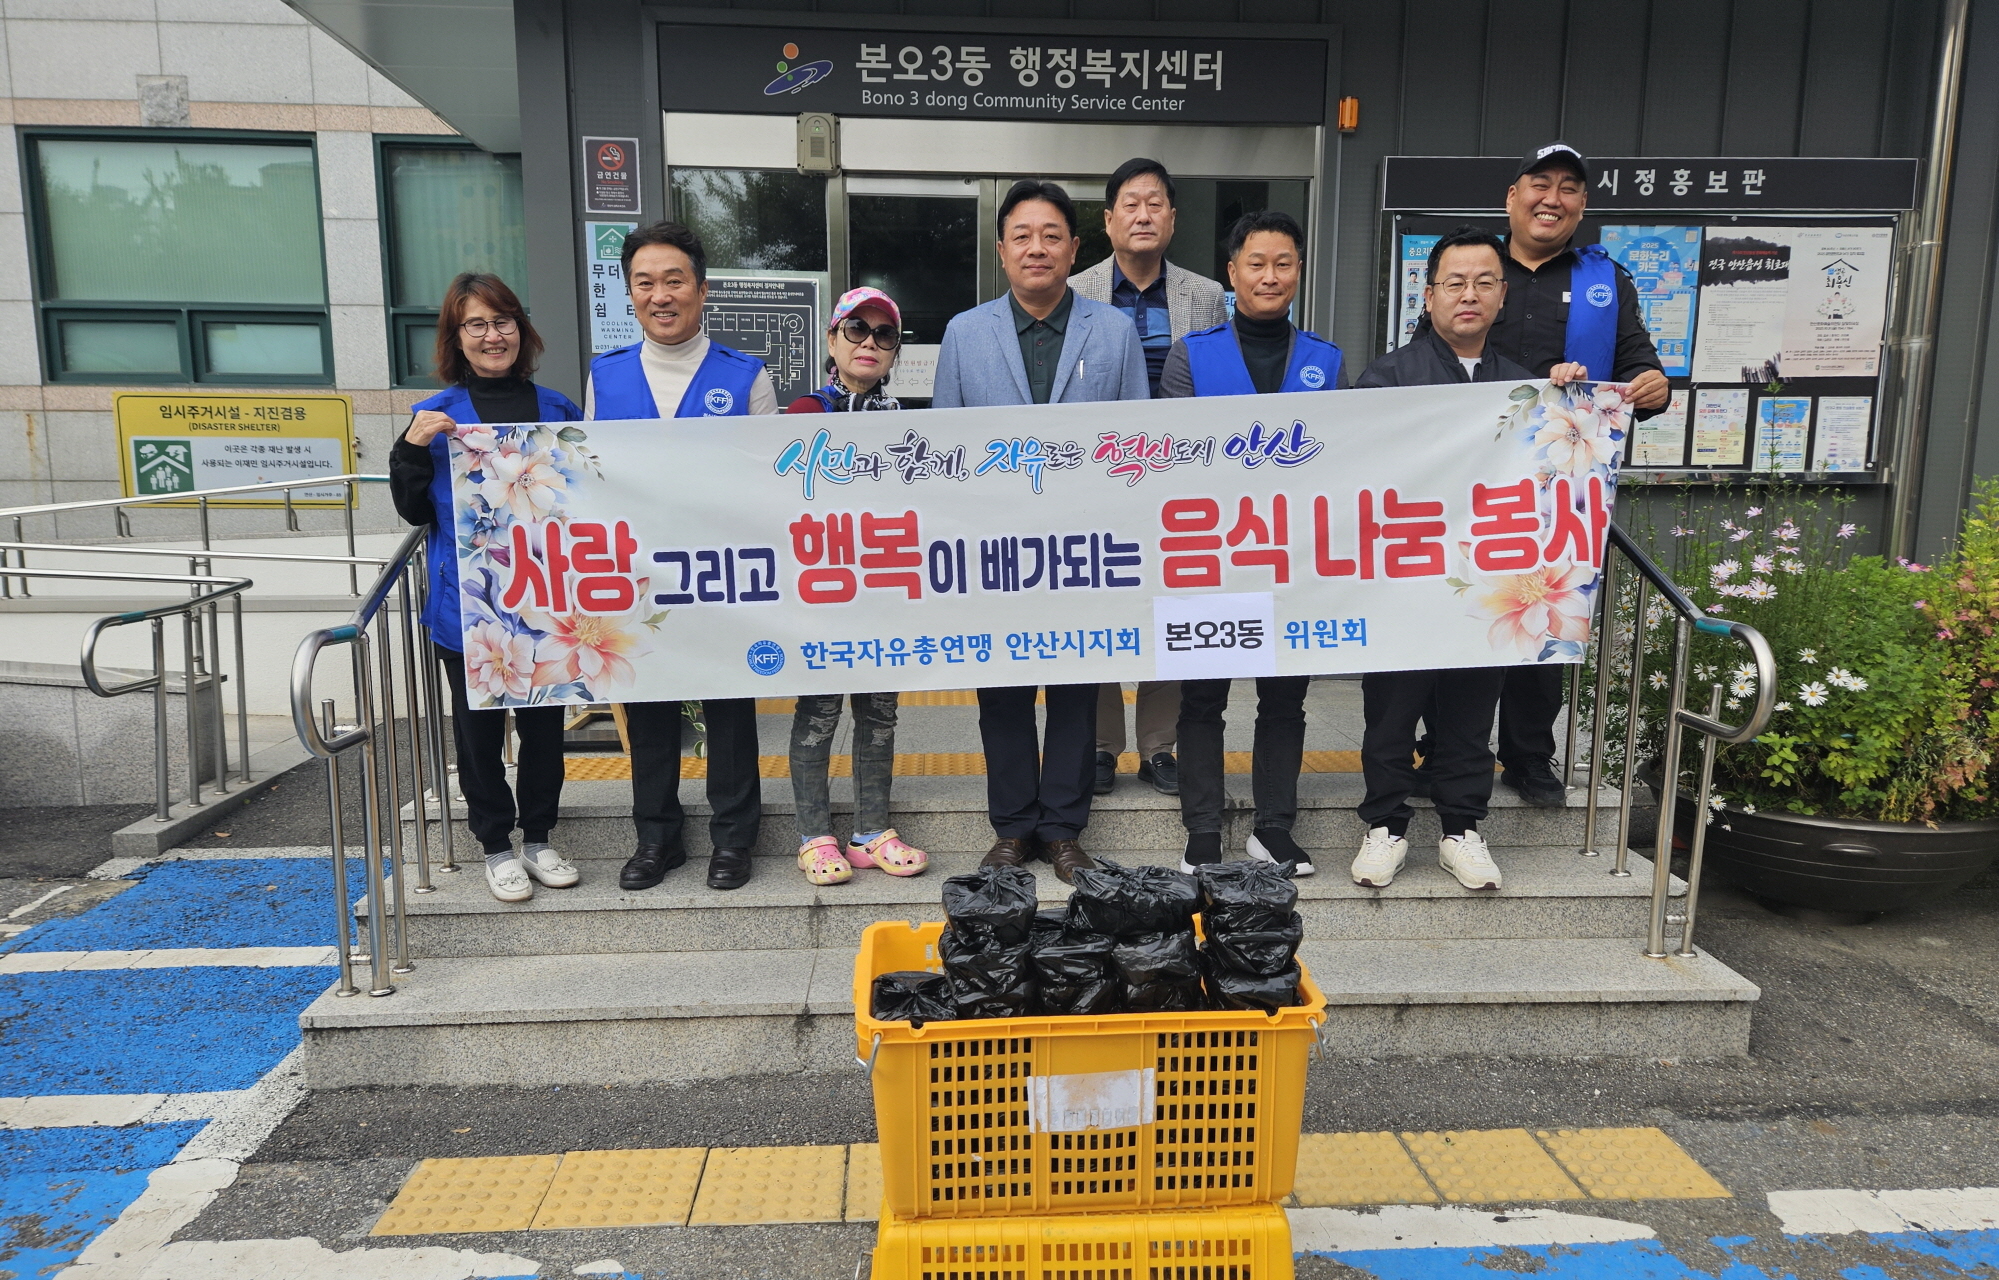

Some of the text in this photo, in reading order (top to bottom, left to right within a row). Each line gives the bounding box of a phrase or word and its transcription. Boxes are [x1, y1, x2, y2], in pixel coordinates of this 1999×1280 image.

[856, 43, 1223, 91] 본오3동 행정복지센터
[862, 90, 1185, 112] Bono 3 dong Community Service Center
[597, 171, 627, 180] 금연건물
[1597, 169, 1766, 196] 시정홍보판
[1629, 250, 1671, 261] 문화누리
[1638, 261, 1659, 273] 카드
[1708, 258, 1726, 270] 전국
[159, 404, 241, 420] 임시주거시설
[253, 406, 307, 421] 지진겸용
[188, 422, 281, 432] (DISASTER SHELTER)
[224, 445, 248, 454] 이곳은
[250, 445, 265, 454] 각종
[268, 445, 284, 454] 재난
[304, 445, 312, 454] 시
[201, 459, 233, 468] 사용되는
[235, 459, 258, 468] 이재민
[774, 428, 891, 500] 시민과
[974, 436, 1085, 494] 자유로운
[1092, 431, 1216, 487] 혁신도시
[1222, 419, 1324, 469] 안산
[502, 476, 1607, 613] 사랑 그리고 행복이 배가되는 음식 나눔 봉사
[800, 617, 1368, 670] 한국자유총연맹 안산시지회 본오3동 위원회
[754, 653, 778, 664] KFF
